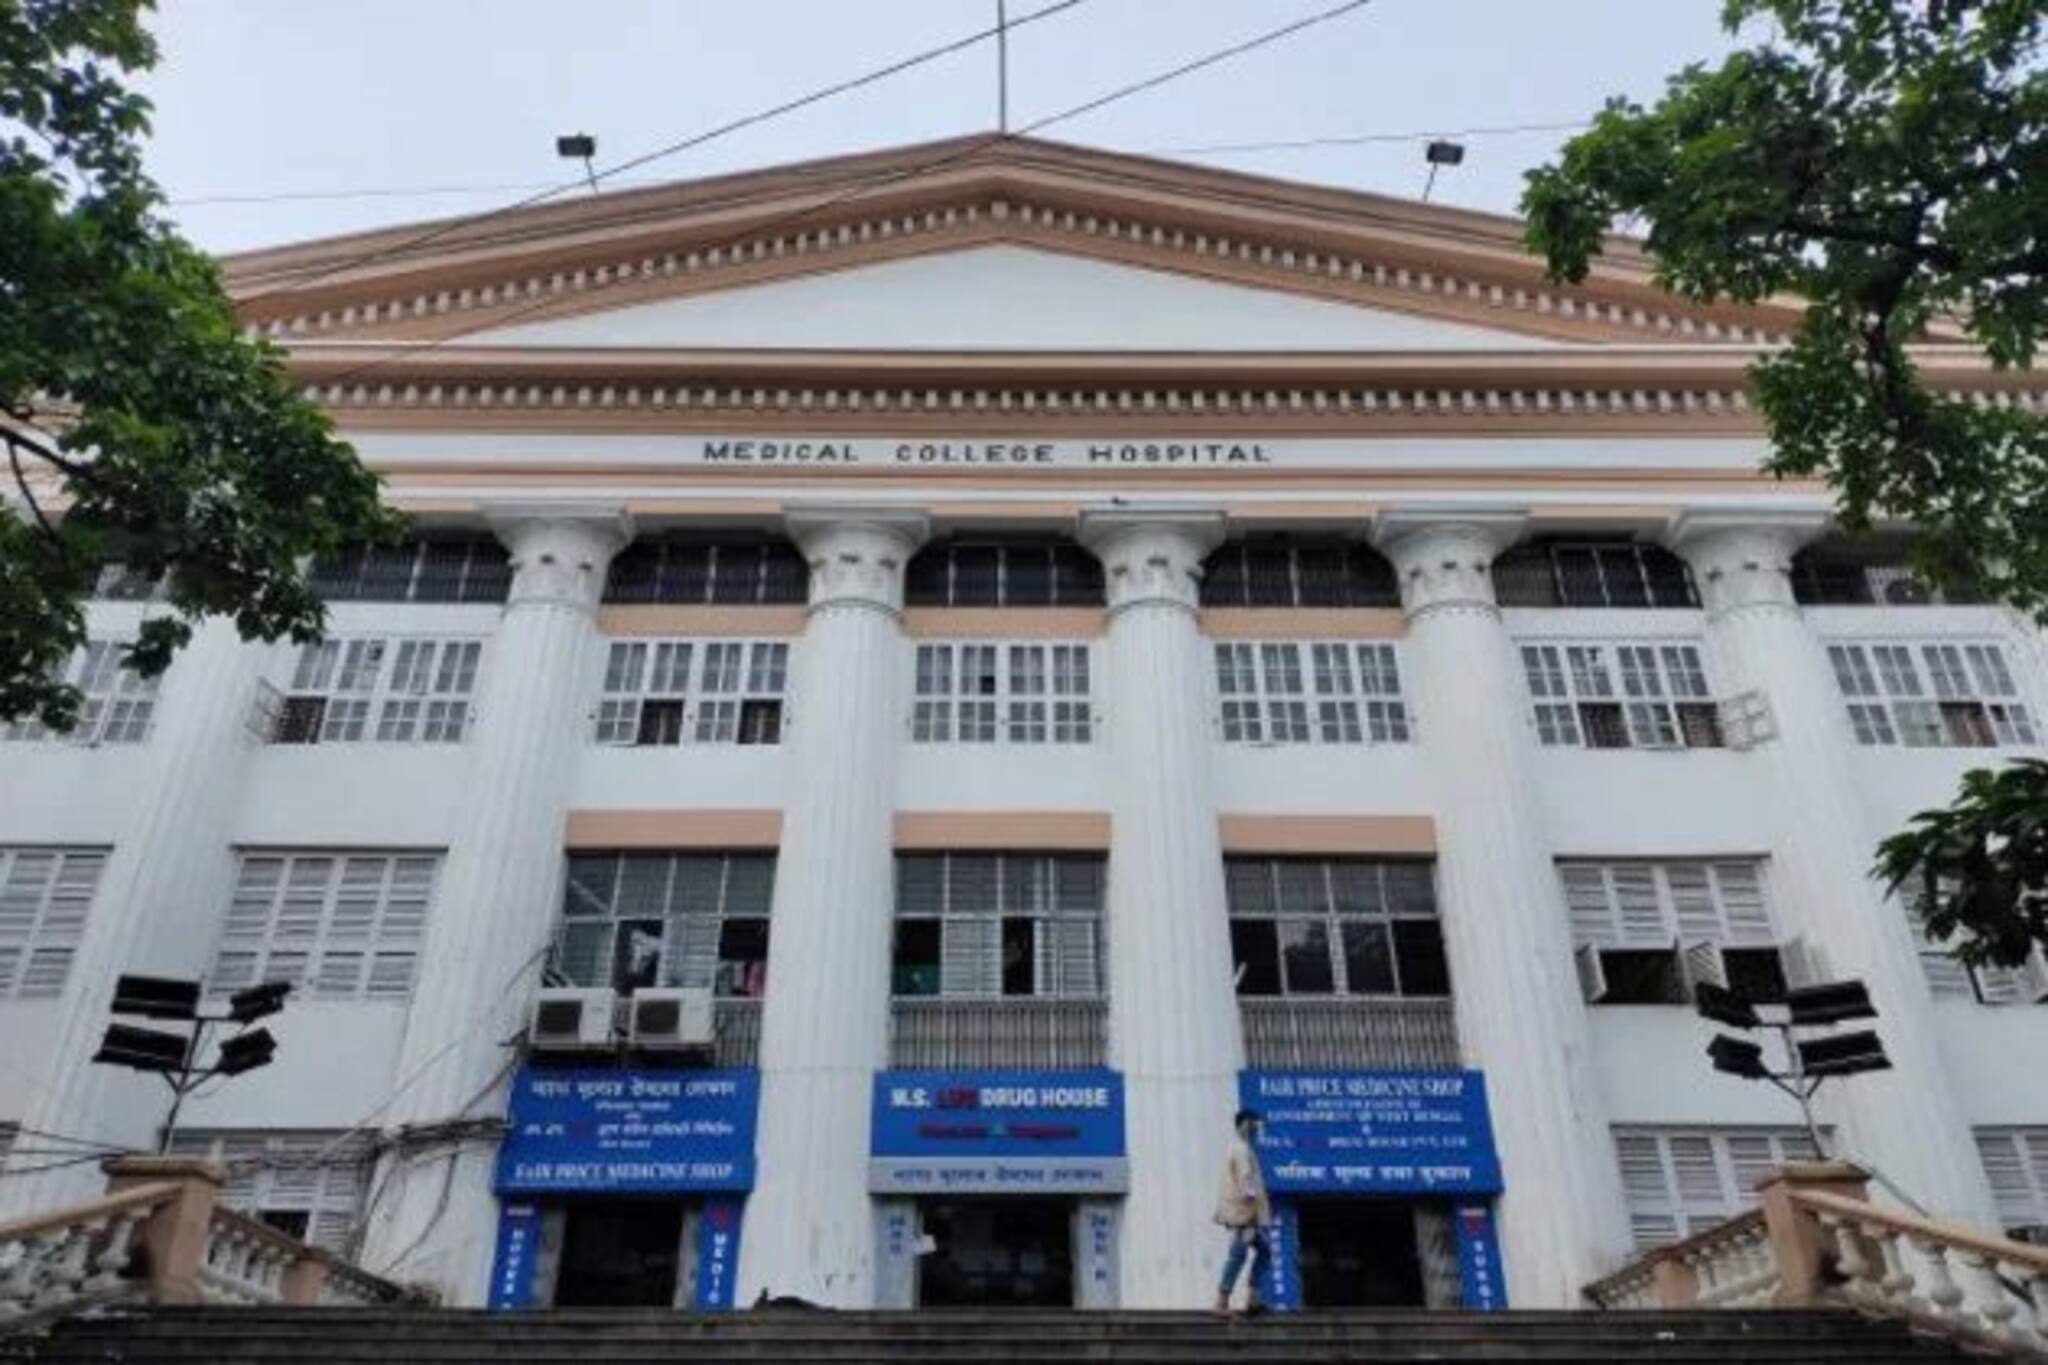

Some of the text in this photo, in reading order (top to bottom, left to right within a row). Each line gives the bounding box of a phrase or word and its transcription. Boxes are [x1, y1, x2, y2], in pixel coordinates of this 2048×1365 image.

[704, 442, 1272, 463] MEDICAL COLLEGE HOSPITAL
[1297, 1078, 1342, 1096] PRICE
[980, 1087, 1037, 1107] DRUG
[1040, 1087, 1109, 1107] HOUSE
[606, 1162, 685, 1180] MEDICINE
